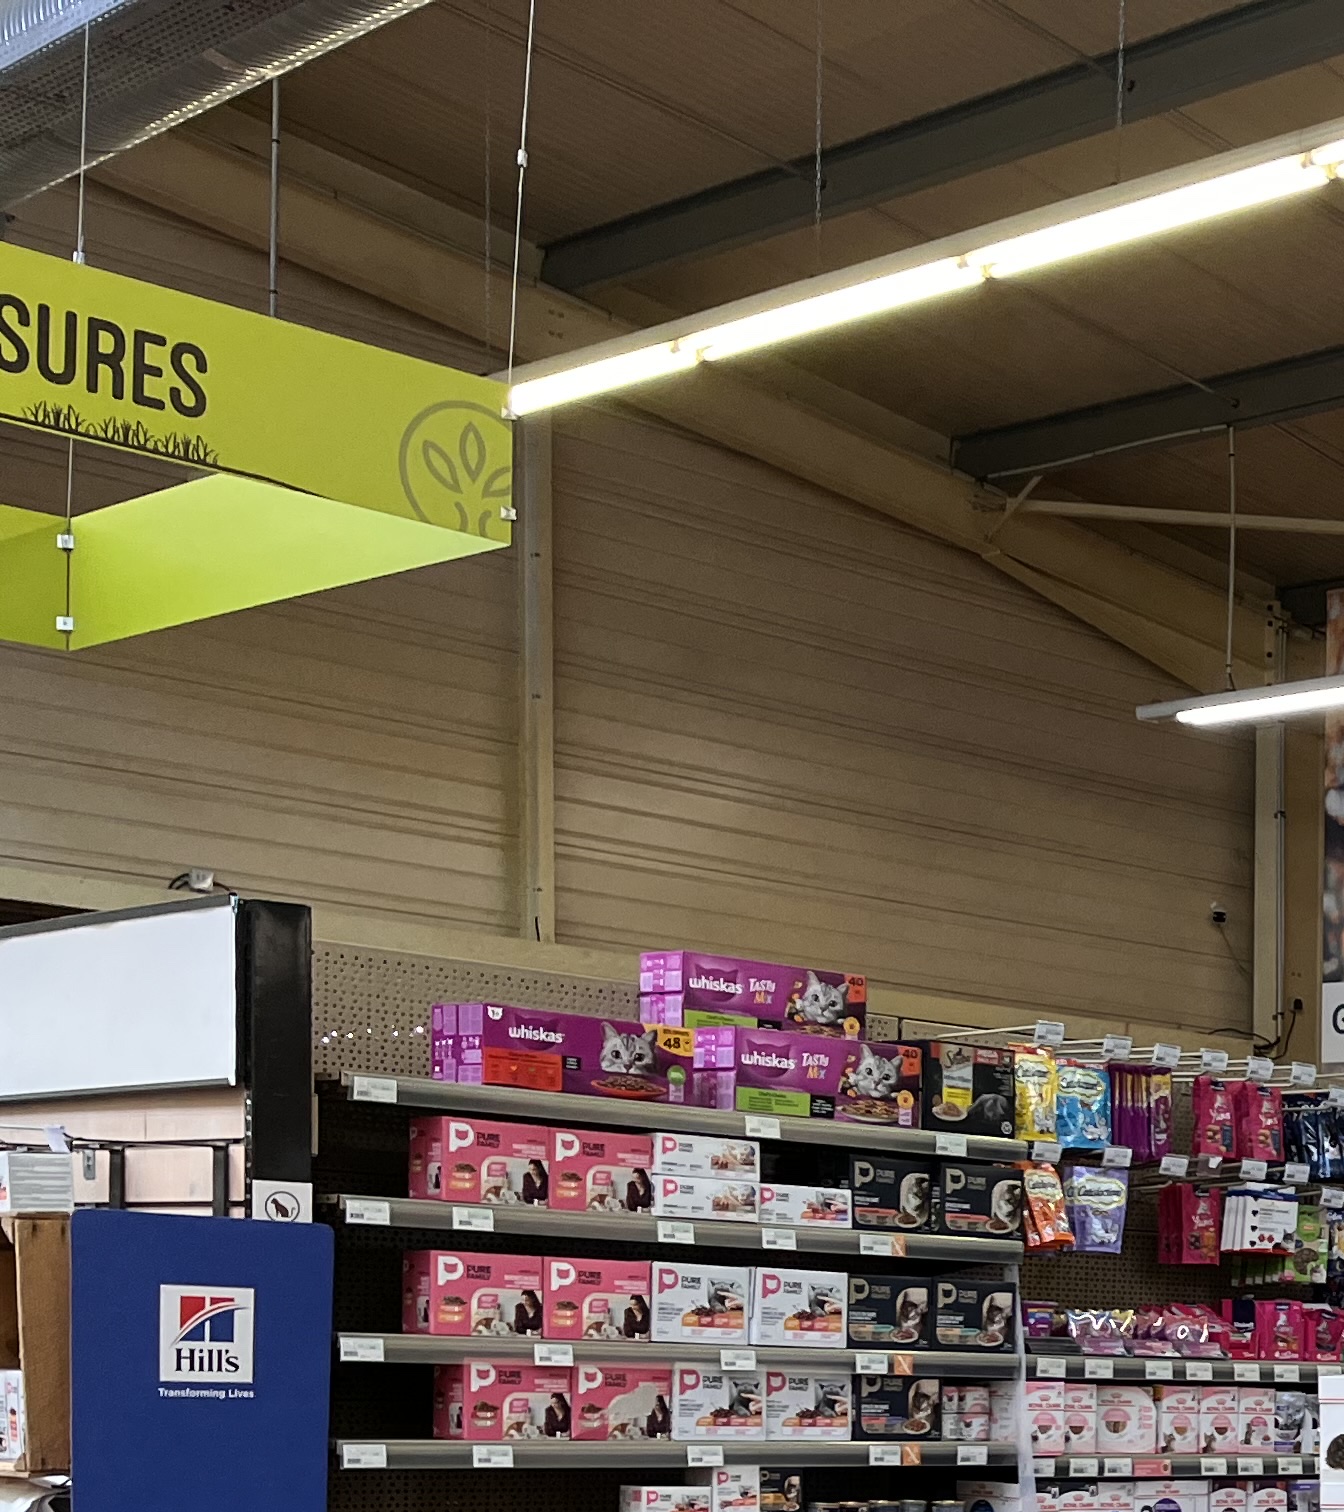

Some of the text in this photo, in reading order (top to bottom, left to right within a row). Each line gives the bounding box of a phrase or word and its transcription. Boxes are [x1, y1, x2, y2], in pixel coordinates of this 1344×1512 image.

[688, 975, 743, 995] whiskas
[508, 1024, 565, 1044] whiskas
[663, 1038, 682, 1050] 48
[741, 1051, 796, 1070] whiskas
[174, 1347, 241, 1374] Hill's
[158, 1387, 226, 1400] Transforming
